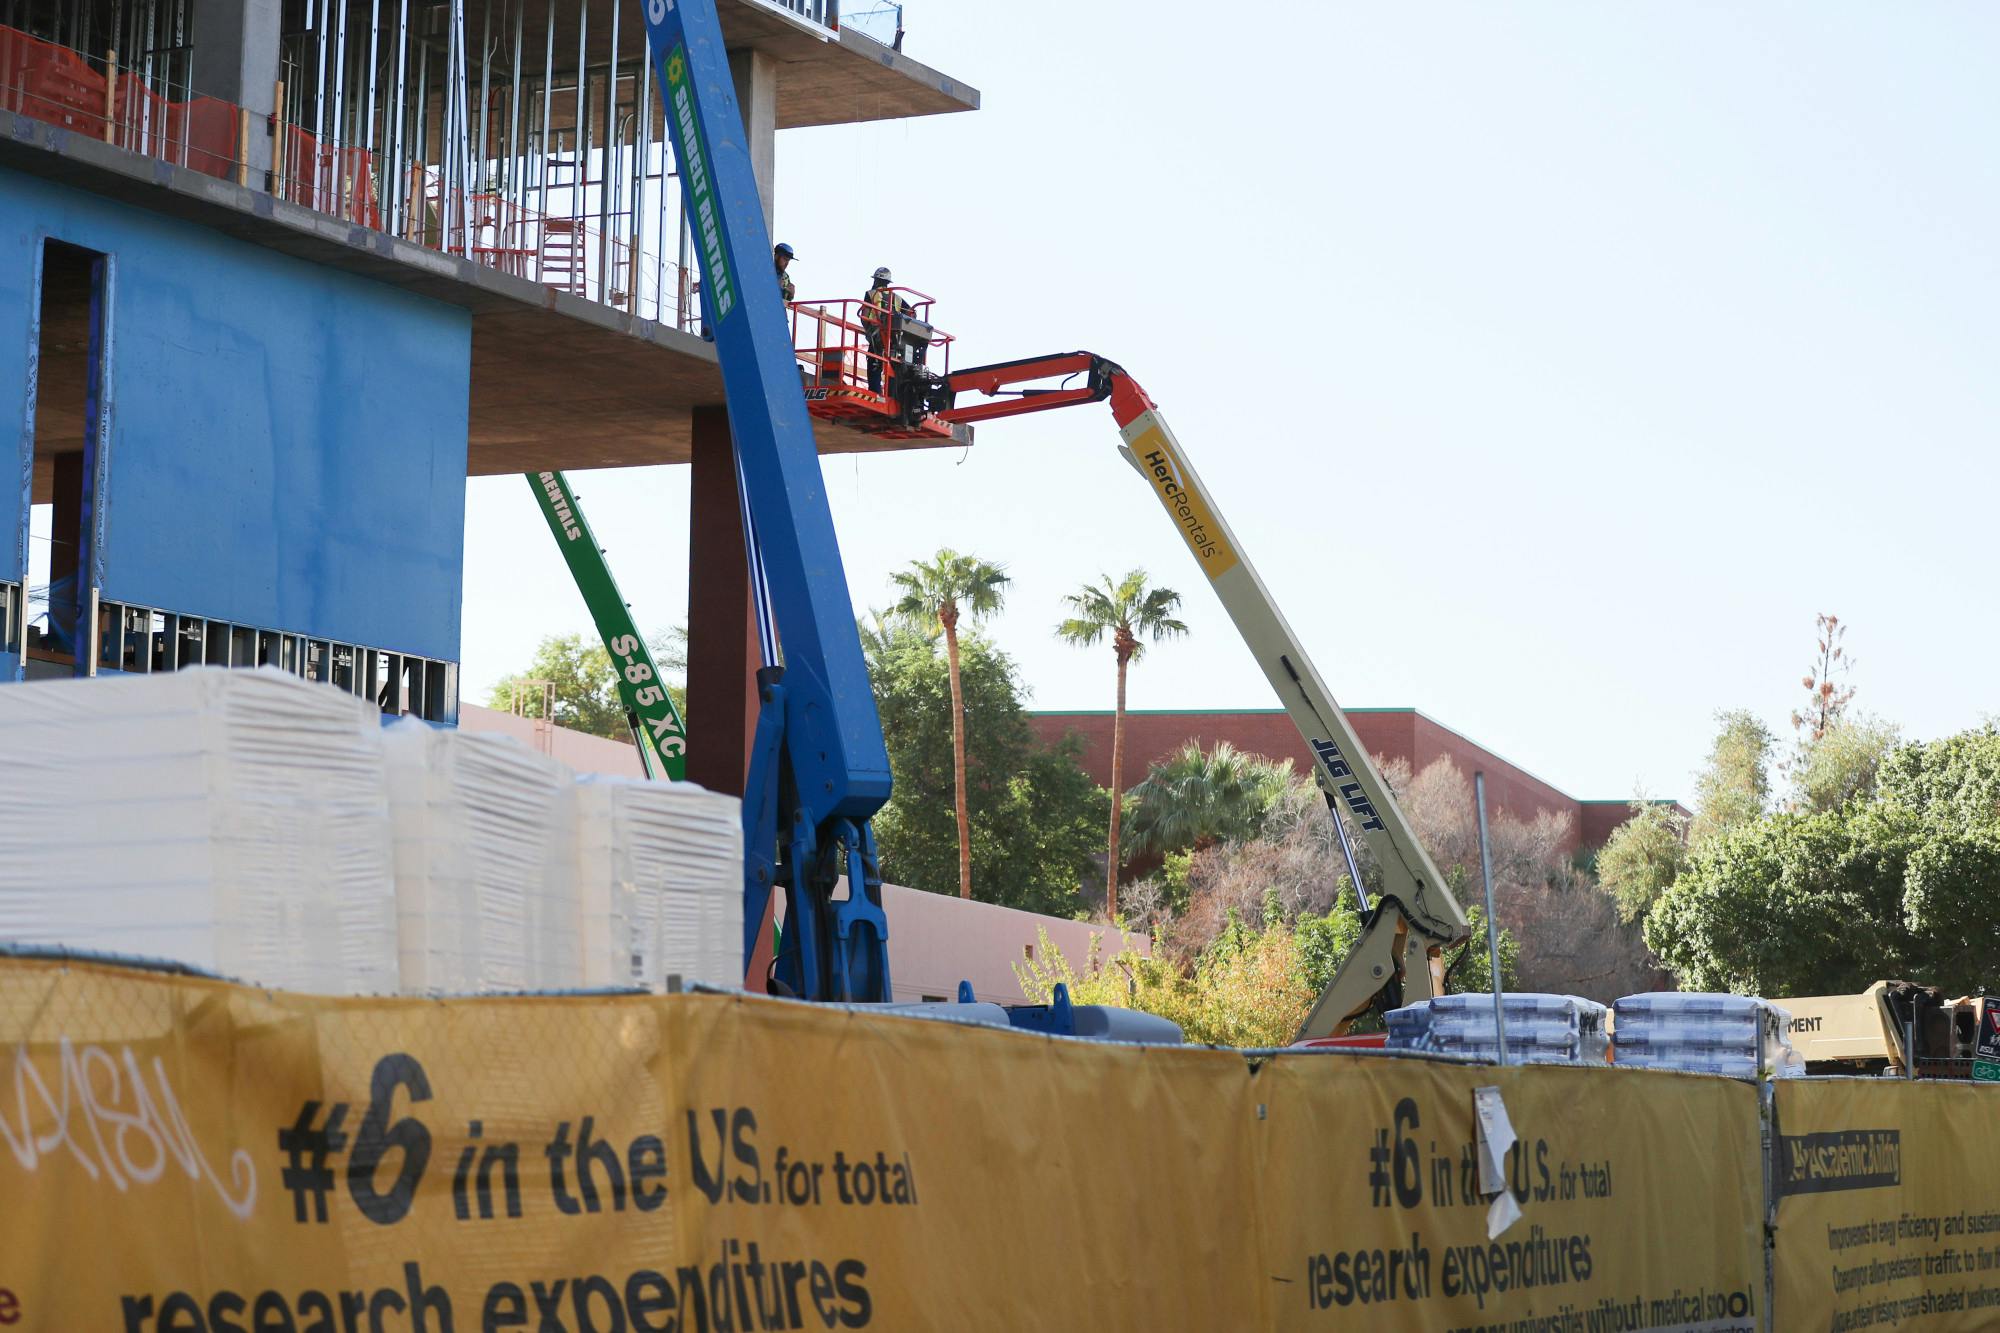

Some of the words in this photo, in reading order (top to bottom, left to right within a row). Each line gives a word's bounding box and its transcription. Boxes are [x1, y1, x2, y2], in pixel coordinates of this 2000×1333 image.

[675, 84, 707, 198] SUNBELT
[699, 196, 731, 316] RENTALS
[538, 471, 582, 541] RENTALS
[1144, 450, 1216, 559] HercRentals
[611, 634, 665, 707] S-85
[646, 711, 686, 758] XC
[1311, 737, 1353, 778] JLG
[1338, 782, 1385, 832] LIFT
[278, 1052, 433, 1226] #6
[451, 1119, 523, 1221] in
[544, 1115, 668, 1216] the
[774, 1146, 824, 1206] for
[833, 1151, 918, 1207] total
[1369, 1097, 1422, 1209] #6
[1431, 1141, 1453, 1207] in
[1510, 1138, 1556, 1204] U.S.
[1559, 1162, 1577, 1200] for
[1580, 1159, 1612, 1198] total
[1308, 1232, 1431, 1309] research
[1442, 1225, 1592, 1309] expenditures
[1925, 1249, 1963, 1276] traffic
[1963, 1249, 1976, 1273] to
[1944, 1211, 1965, 1236] and
[120, 1261, 454, 1333] research
[481, 1238, 873, 1333] expenditures
[1650, 1287, 1704, 1328] medical
[1921, 1288, 1966, 1315] shaded
